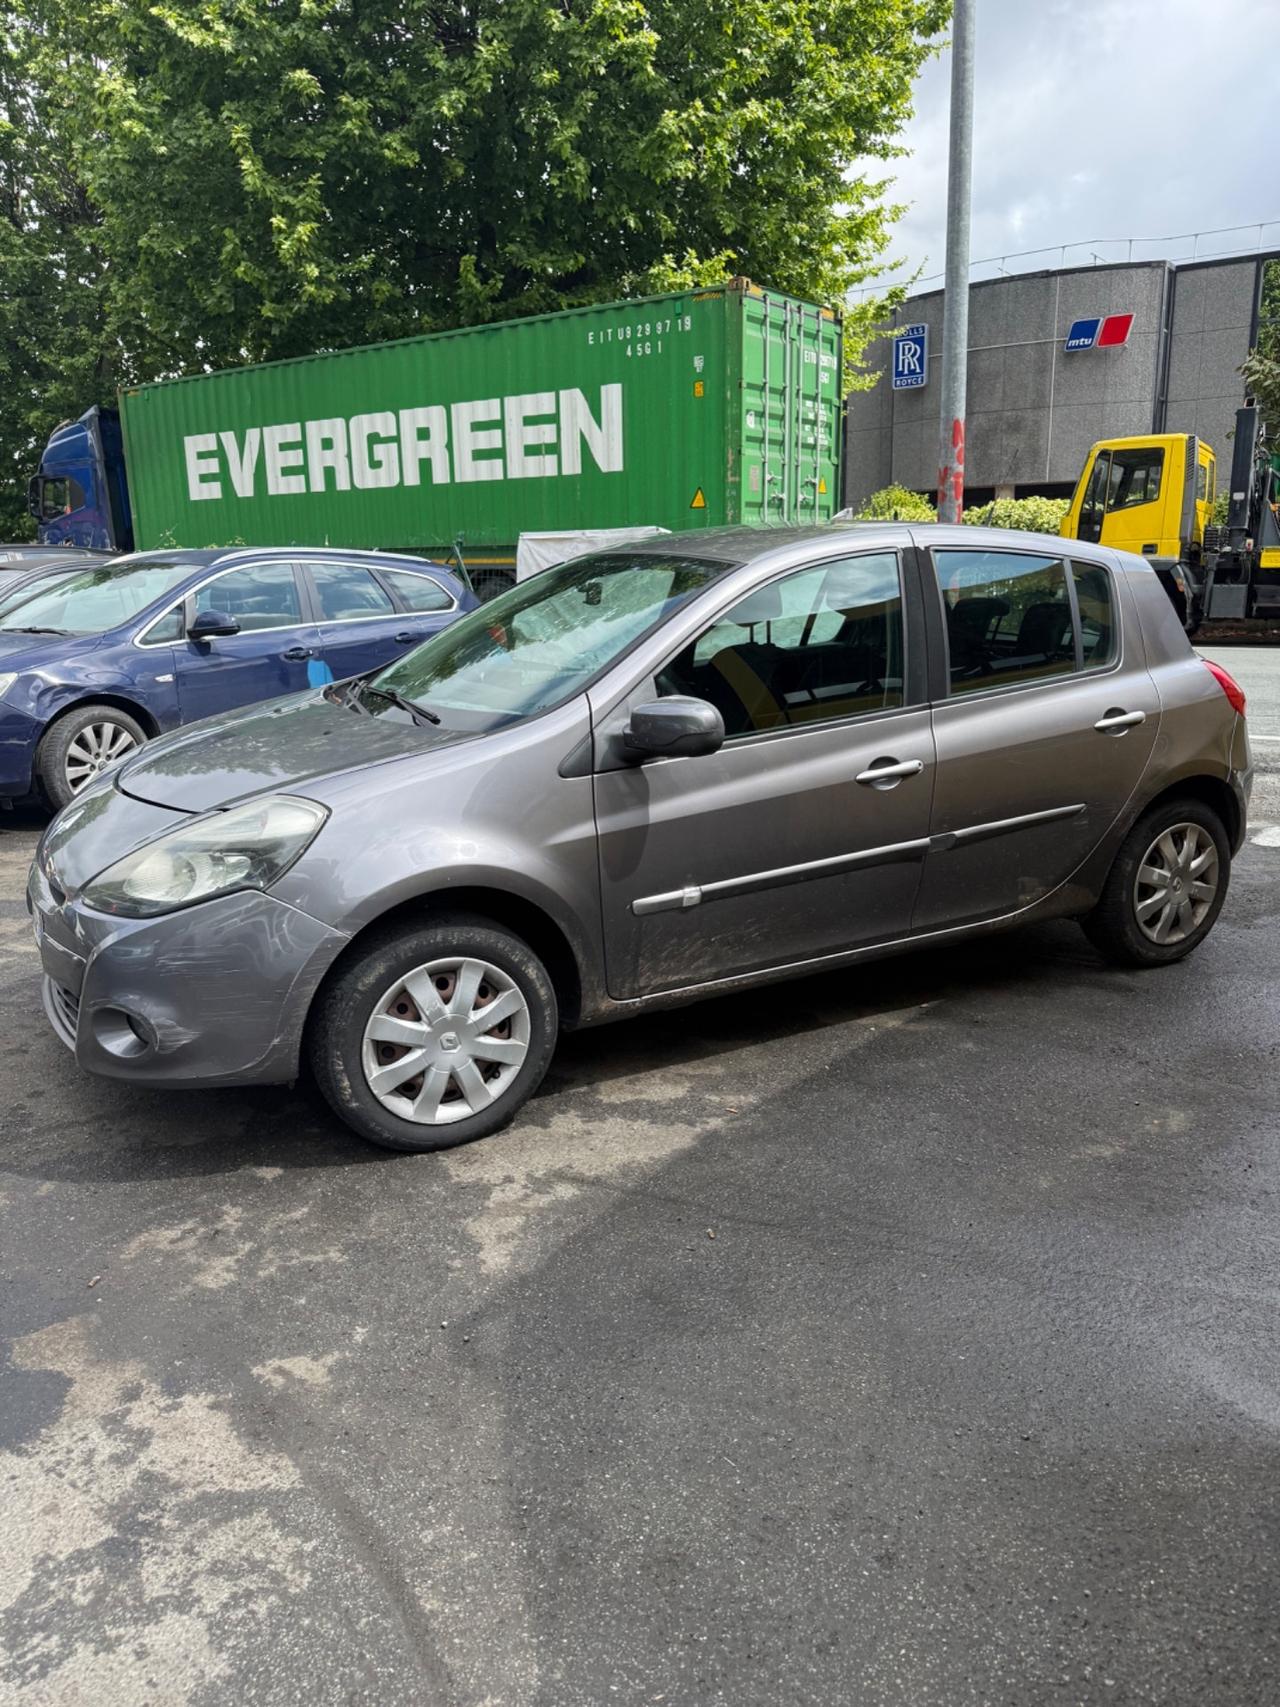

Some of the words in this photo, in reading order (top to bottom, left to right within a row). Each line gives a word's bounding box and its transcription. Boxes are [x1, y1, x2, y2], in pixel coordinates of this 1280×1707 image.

[897, 327, 923, 337] OLLS
[1068, 338, 1093, 347] mtu
[896, 377, 923, 386] ROYCE
[183, 383, 624, 501] EVERGREEN
